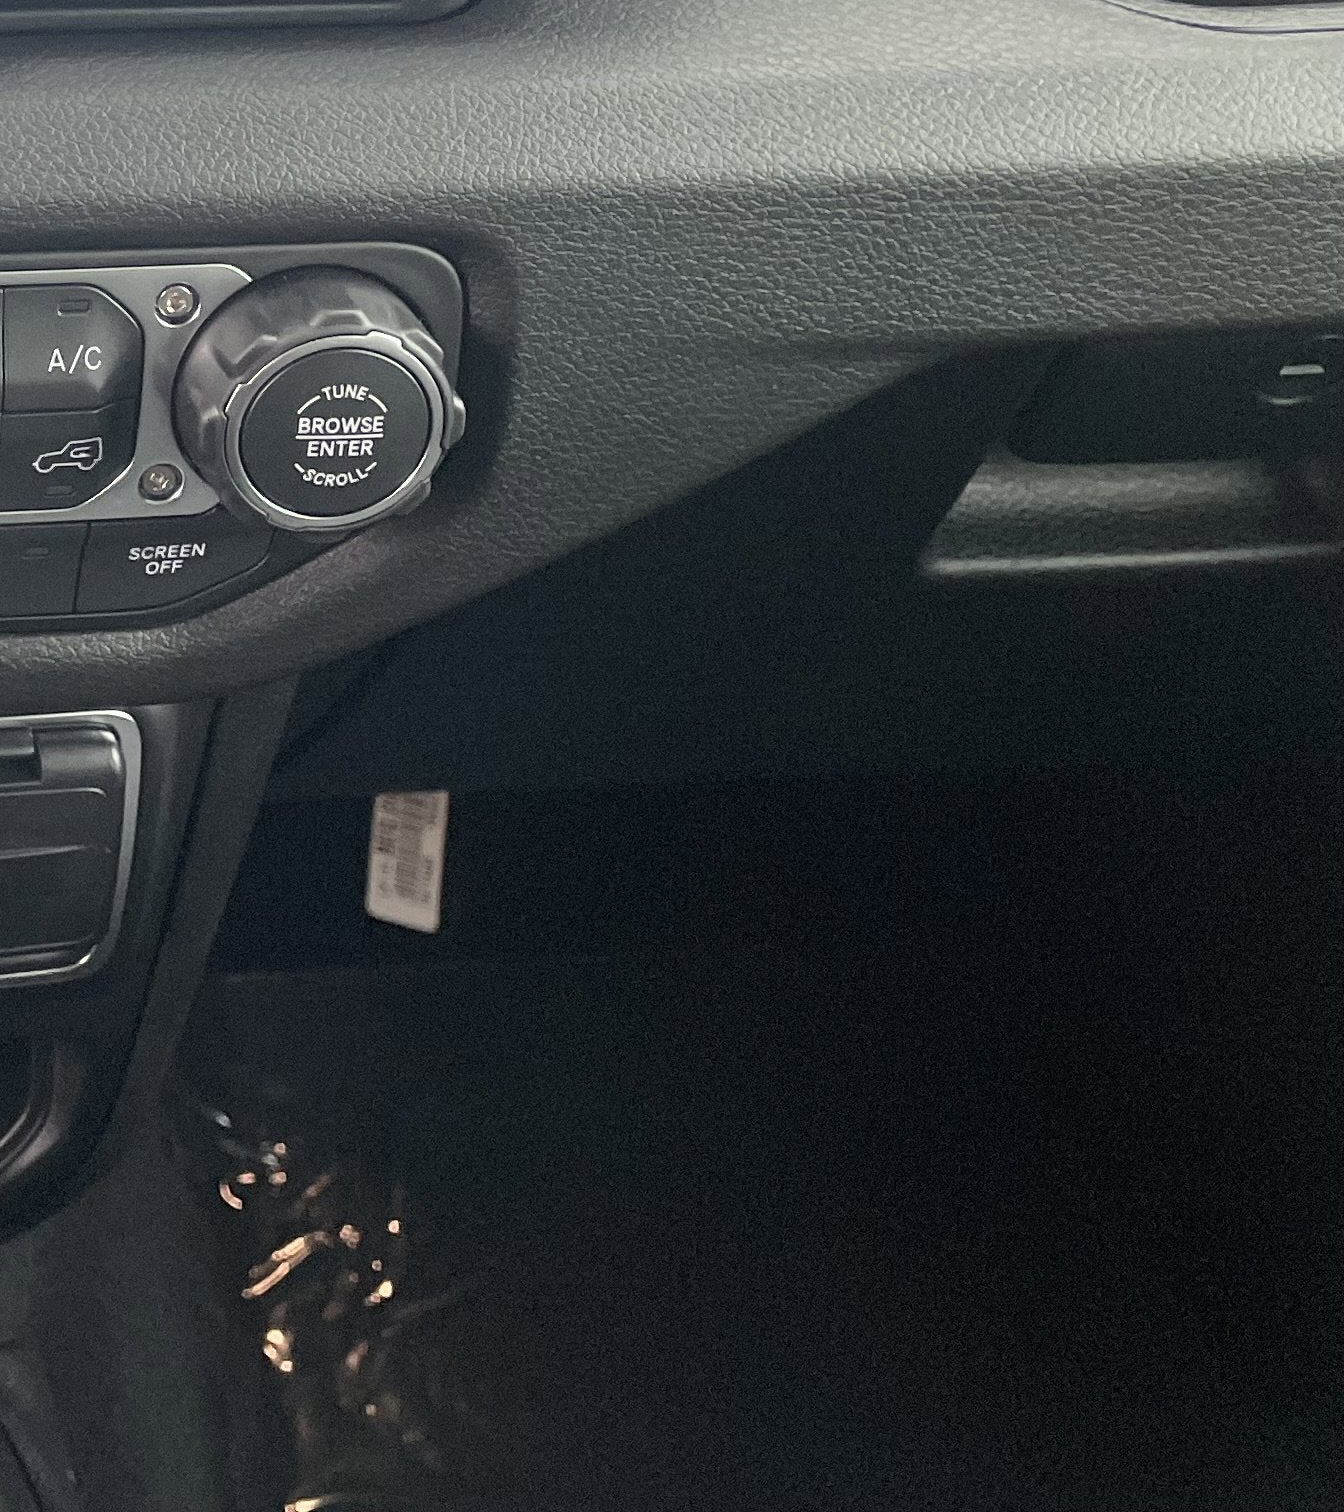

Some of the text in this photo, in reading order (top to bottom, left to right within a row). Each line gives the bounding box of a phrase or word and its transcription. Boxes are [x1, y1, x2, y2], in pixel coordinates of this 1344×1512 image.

[47, 344, 103, 374] A/C
[321, 384, 370, 401] TUNE
[297, 415, 385, 434] BROWSE
[306, 439, 374, 457] ENTER
[302, 468, 369, 487] SCROLL
[128, 544, 206, 566] SCREEN
[142, 557, 184, 575] OFF
